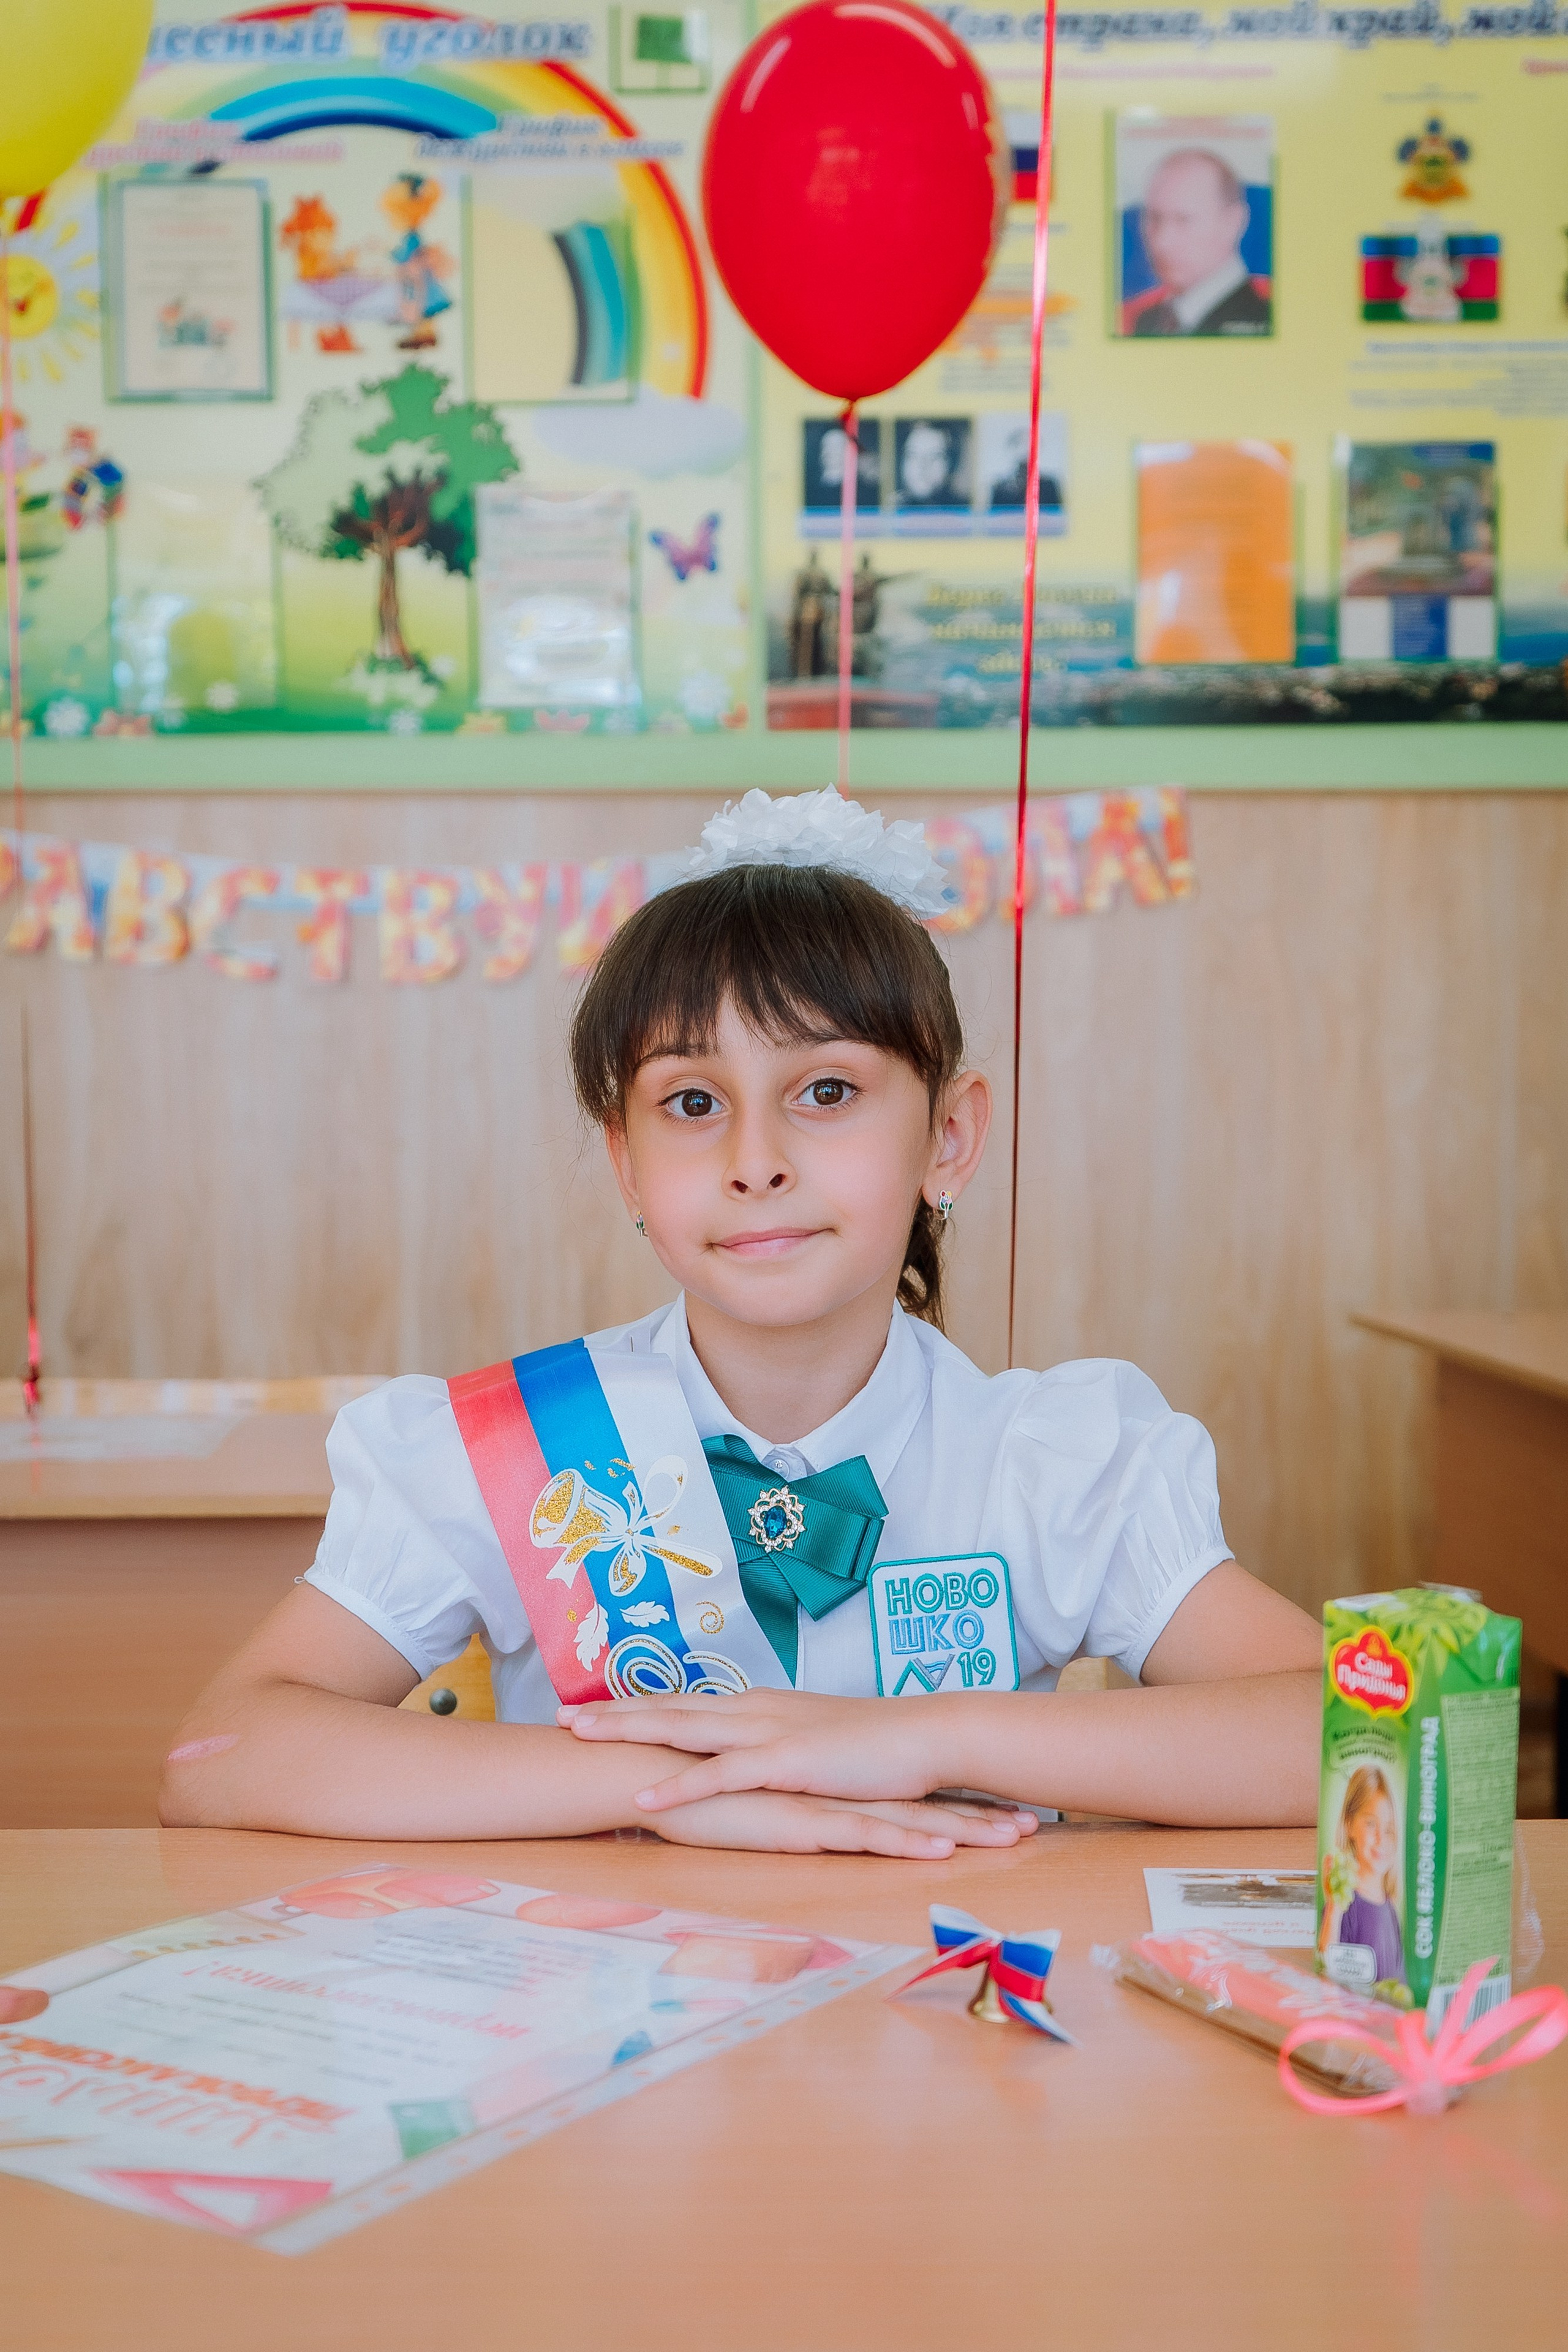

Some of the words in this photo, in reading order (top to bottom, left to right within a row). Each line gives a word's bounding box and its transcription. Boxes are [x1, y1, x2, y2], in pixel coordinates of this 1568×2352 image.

[150, 7, 346, 58] ссный
[383, 23, 589, 65] уголок
[885, 1568, 999, 1616] НОВО
[888, 1610, 984, 1655] ШКО
[1336, 1663, 1406, 1702] Придонья
[1354, 1651, 1393, 1680] Сады
[1414, 1716, 1440, 1913] ЯБЛОКО-ВИНОГРАД
[1414, 1915, 1434, 1959] СОК
